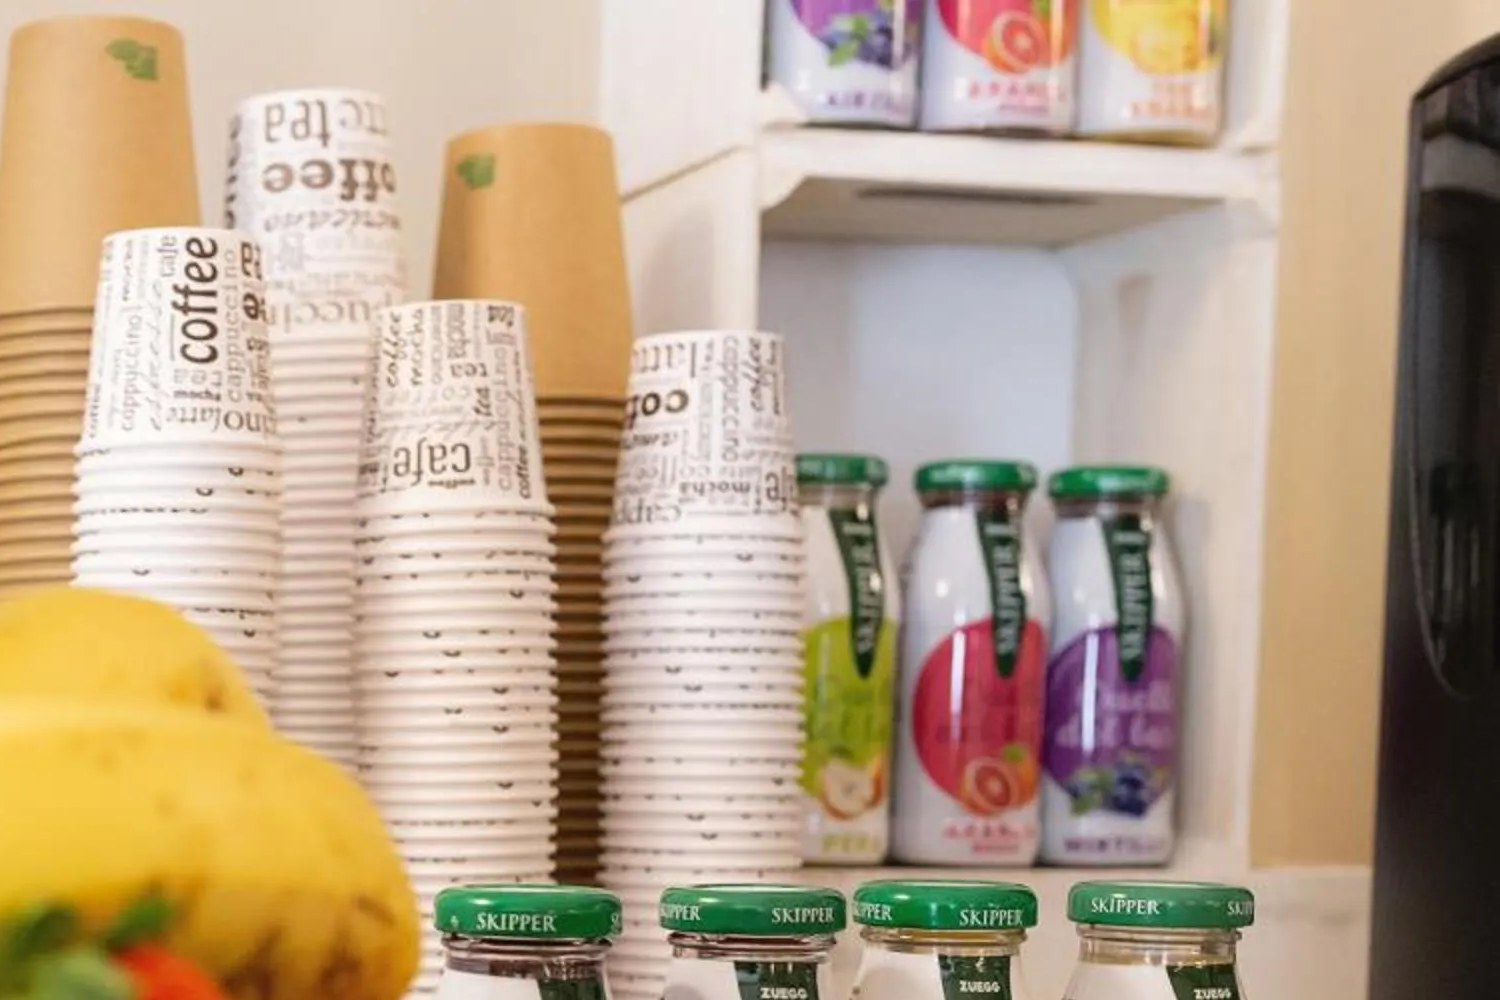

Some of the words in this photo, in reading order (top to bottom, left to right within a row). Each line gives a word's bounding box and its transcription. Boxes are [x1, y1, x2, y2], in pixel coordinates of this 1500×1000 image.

[264, 99, 331, 148] tea
[171, 236, 219, 364] coffee
[222, 249, 246, 402] cappuccino
[393, 437, 471, 487] cafe
[679, 480, 751, 496] mocha
[771, 907, 834, 923] SKIPPER
[1091, 897, 1160, 915] SKIPPER
[476, 912, 557, 932] SKIPPER
[960, 908, 1024, 926] SKIPPER
[760, 986, 808, 999] ZUEGG
[959, 980, 1001, 993] ZUEGG
[1193, 987, 1231, 1000] ZUEGG
